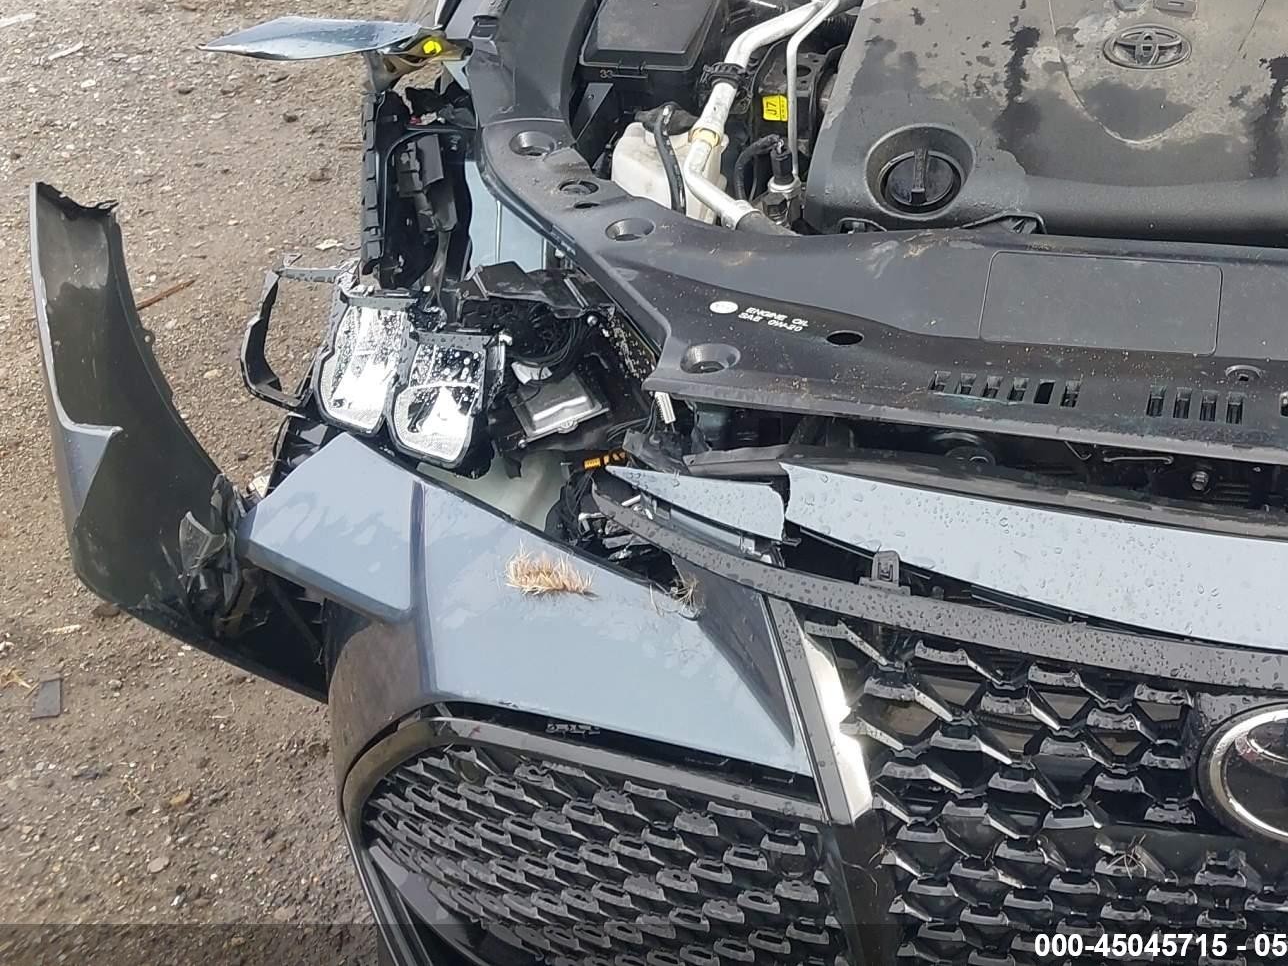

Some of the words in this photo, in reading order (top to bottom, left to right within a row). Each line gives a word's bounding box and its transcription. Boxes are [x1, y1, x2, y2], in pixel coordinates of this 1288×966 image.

[738, 312, 763, 322] SAE
[767, 319, 804, 332] 0W-20
[745, 307, 788, 321] ENGINE
[791, 318, 809, 327] OIL
